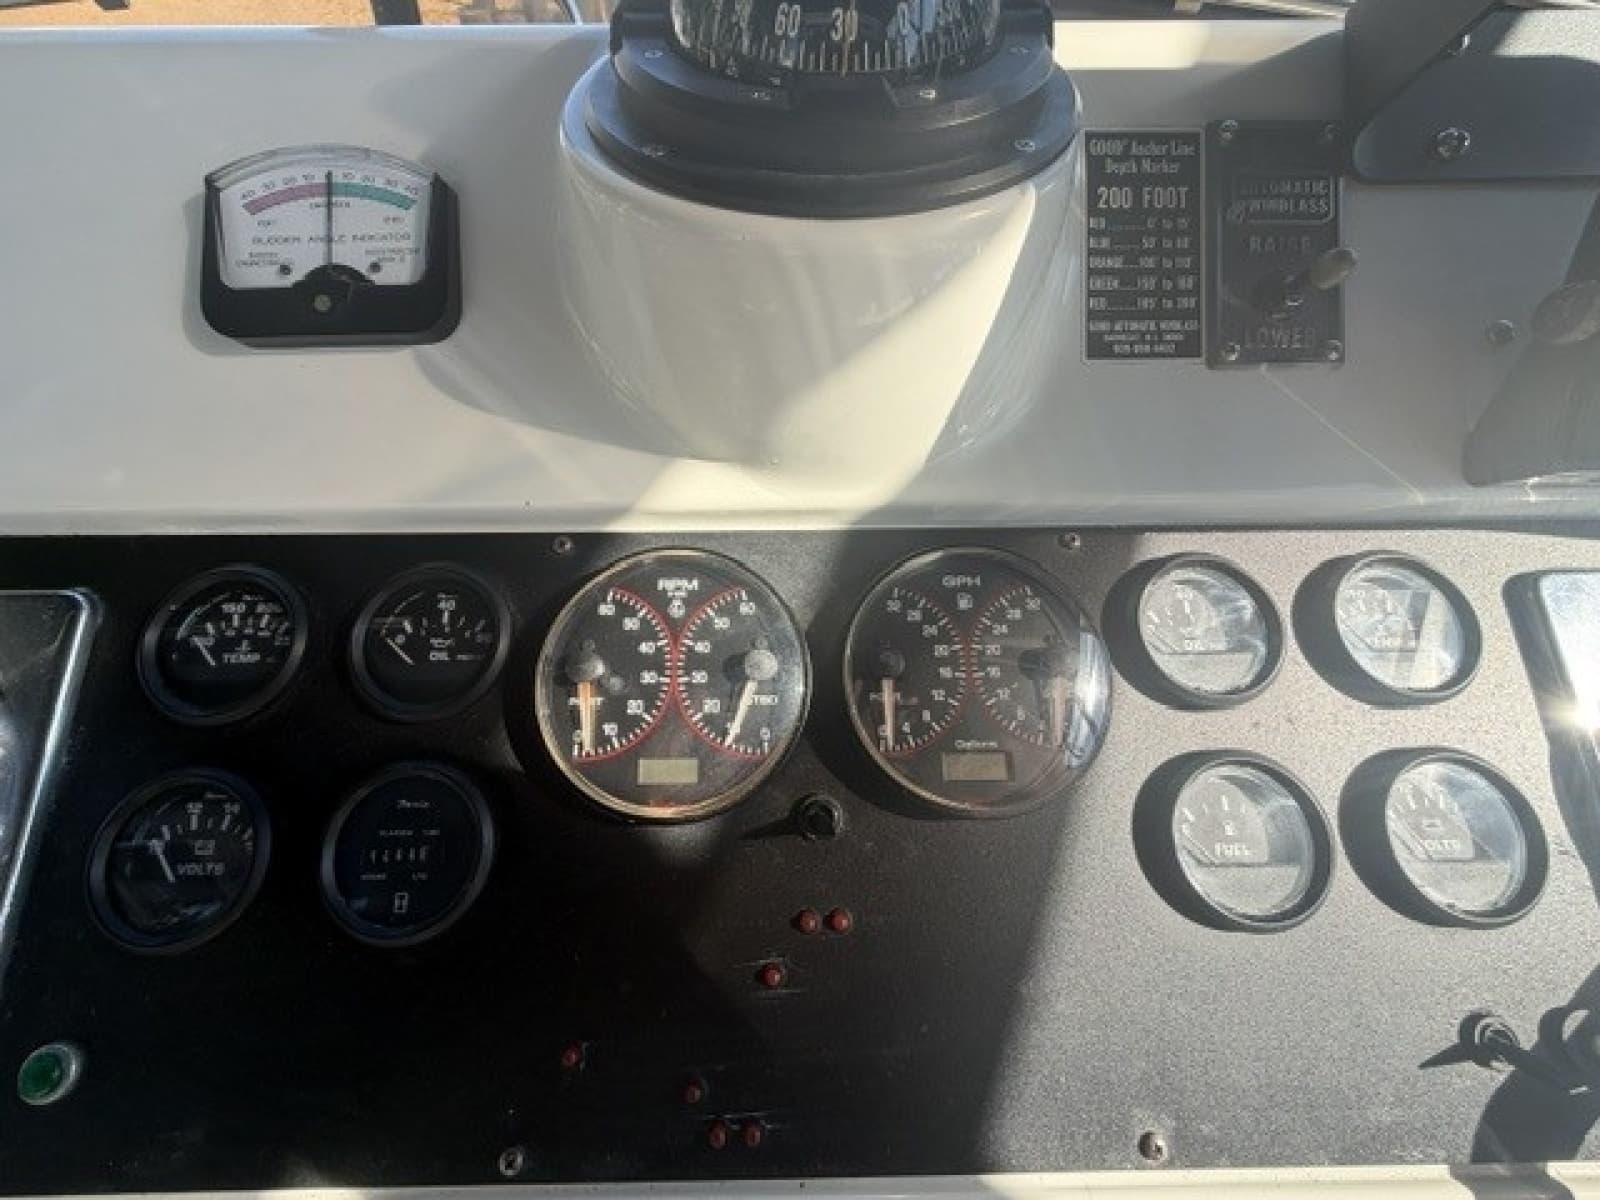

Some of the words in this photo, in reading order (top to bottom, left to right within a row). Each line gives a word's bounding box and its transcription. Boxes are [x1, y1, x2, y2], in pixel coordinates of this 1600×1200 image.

[774, 2, 799, 38] 60
[831, 6, 858, 41] 30
[1096, 187, 1132, 208] 200
[1142, 187, 1189, 208] FOOT
[1250, 200, 1329, 213] WINDLASS
[1245, 328, 1317, 348] LOWER
[657, 577, 698, 590] RPM
[942, 575, 981, 587] GPH
[638, 642, 656, 654] 40
[694, 641, 712, 654] 40
[691, 671, 709, 684] 30
[703, 698, 720, 714] 20
[602, 722, 618, 736] 10
[760, 726, 771, 741] 0
[1214, 842, 1252, 857] FUEL
[177, 863, 226, 876] VOLTS
